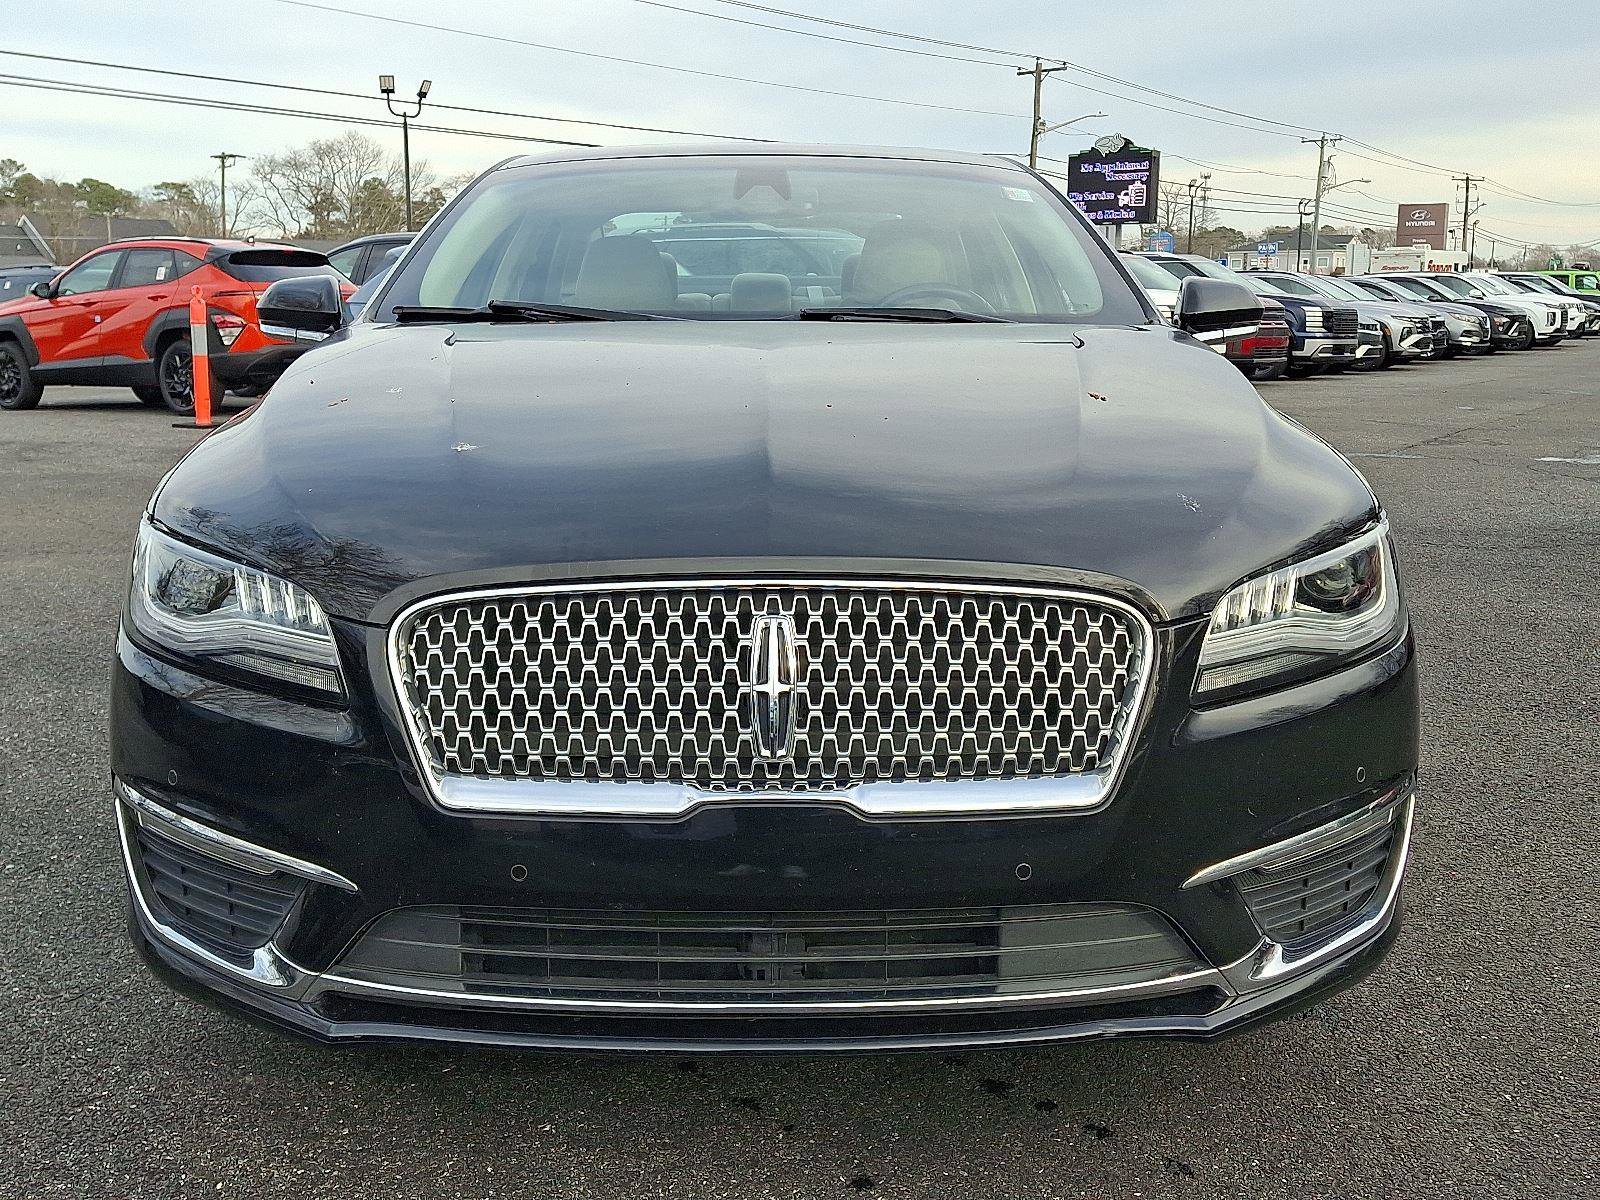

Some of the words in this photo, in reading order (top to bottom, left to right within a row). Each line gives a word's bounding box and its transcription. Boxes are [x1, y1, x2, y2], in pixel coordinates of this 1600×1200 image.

[1080, 163, 1094, 173] No
[1105, 172, 1149, 181] Necessary
[1084, 191, 1115, 200] Service
